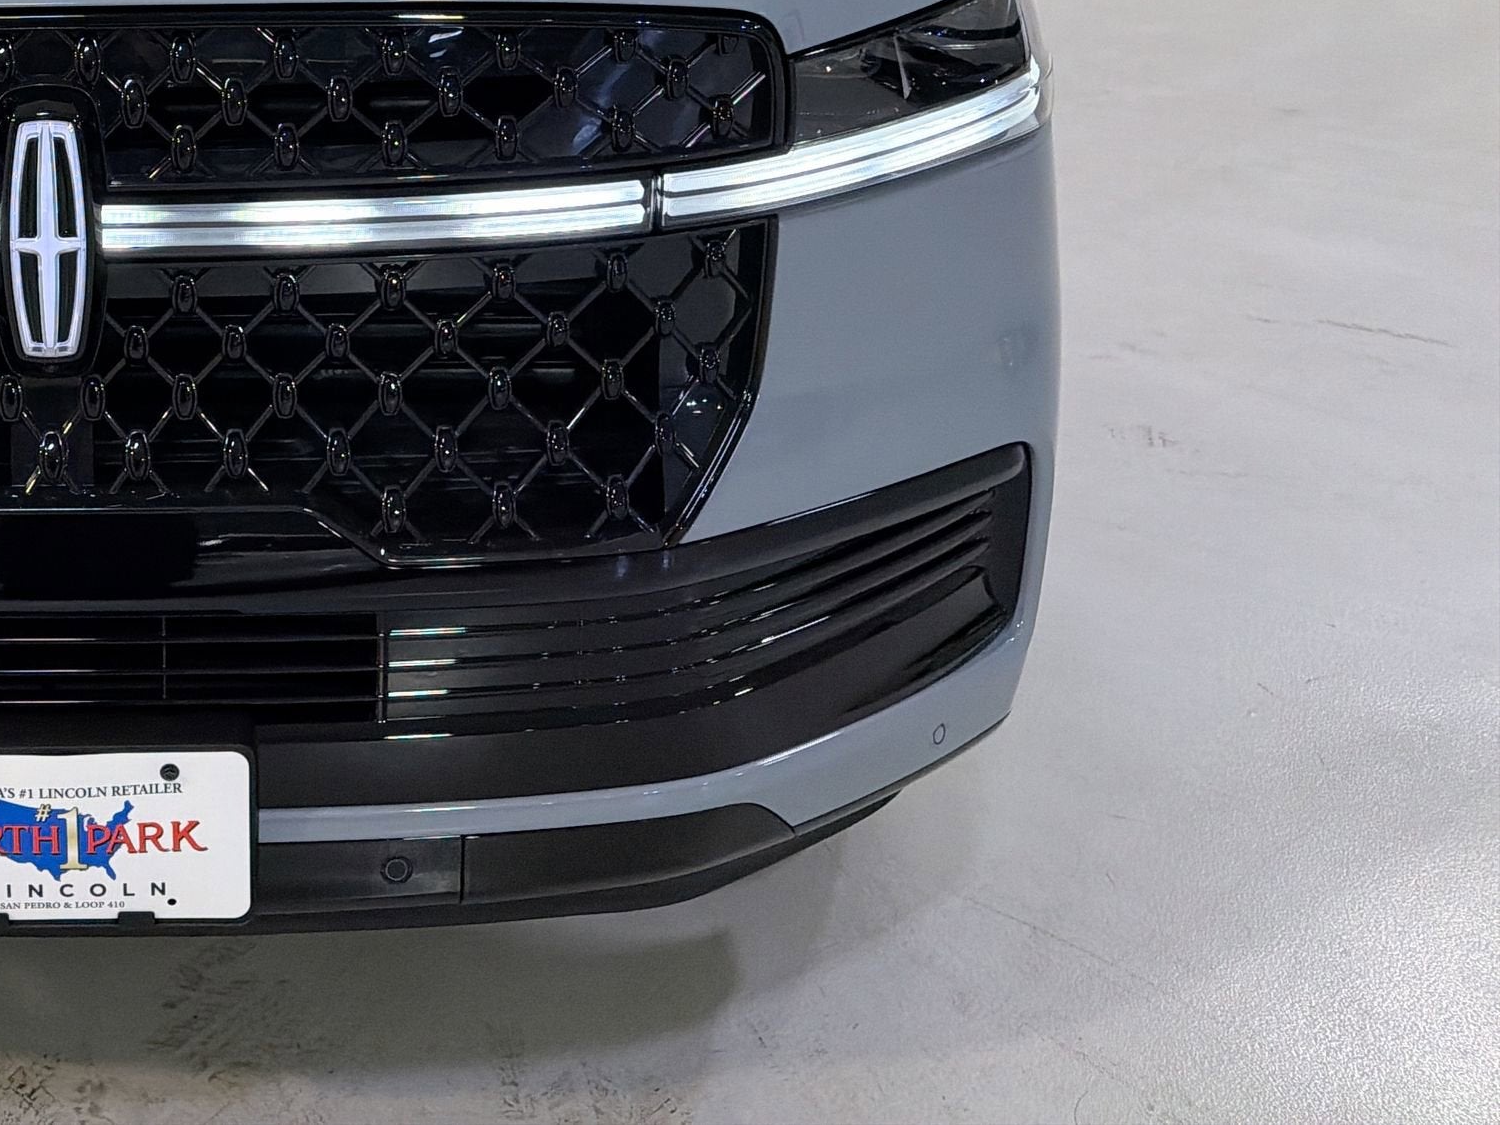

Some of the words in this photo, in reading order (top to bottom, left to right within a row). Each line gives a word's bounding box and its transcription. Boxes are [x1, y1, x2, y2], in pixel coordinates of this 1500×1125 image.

[19, 788, 33, 799] #1
[39, 786, 107, 799] LINCOLN
[111, 782, 183, 797] RETAILER
[86, 820, 208, 854] PARK
[0, 902, 21, 910] SAN
[24, 901, 61, 910] PEDRO
[63, 901, 73, 909] &
[75, 901, 105, 909] LOOP
[107, 900, 125, 909] 410
